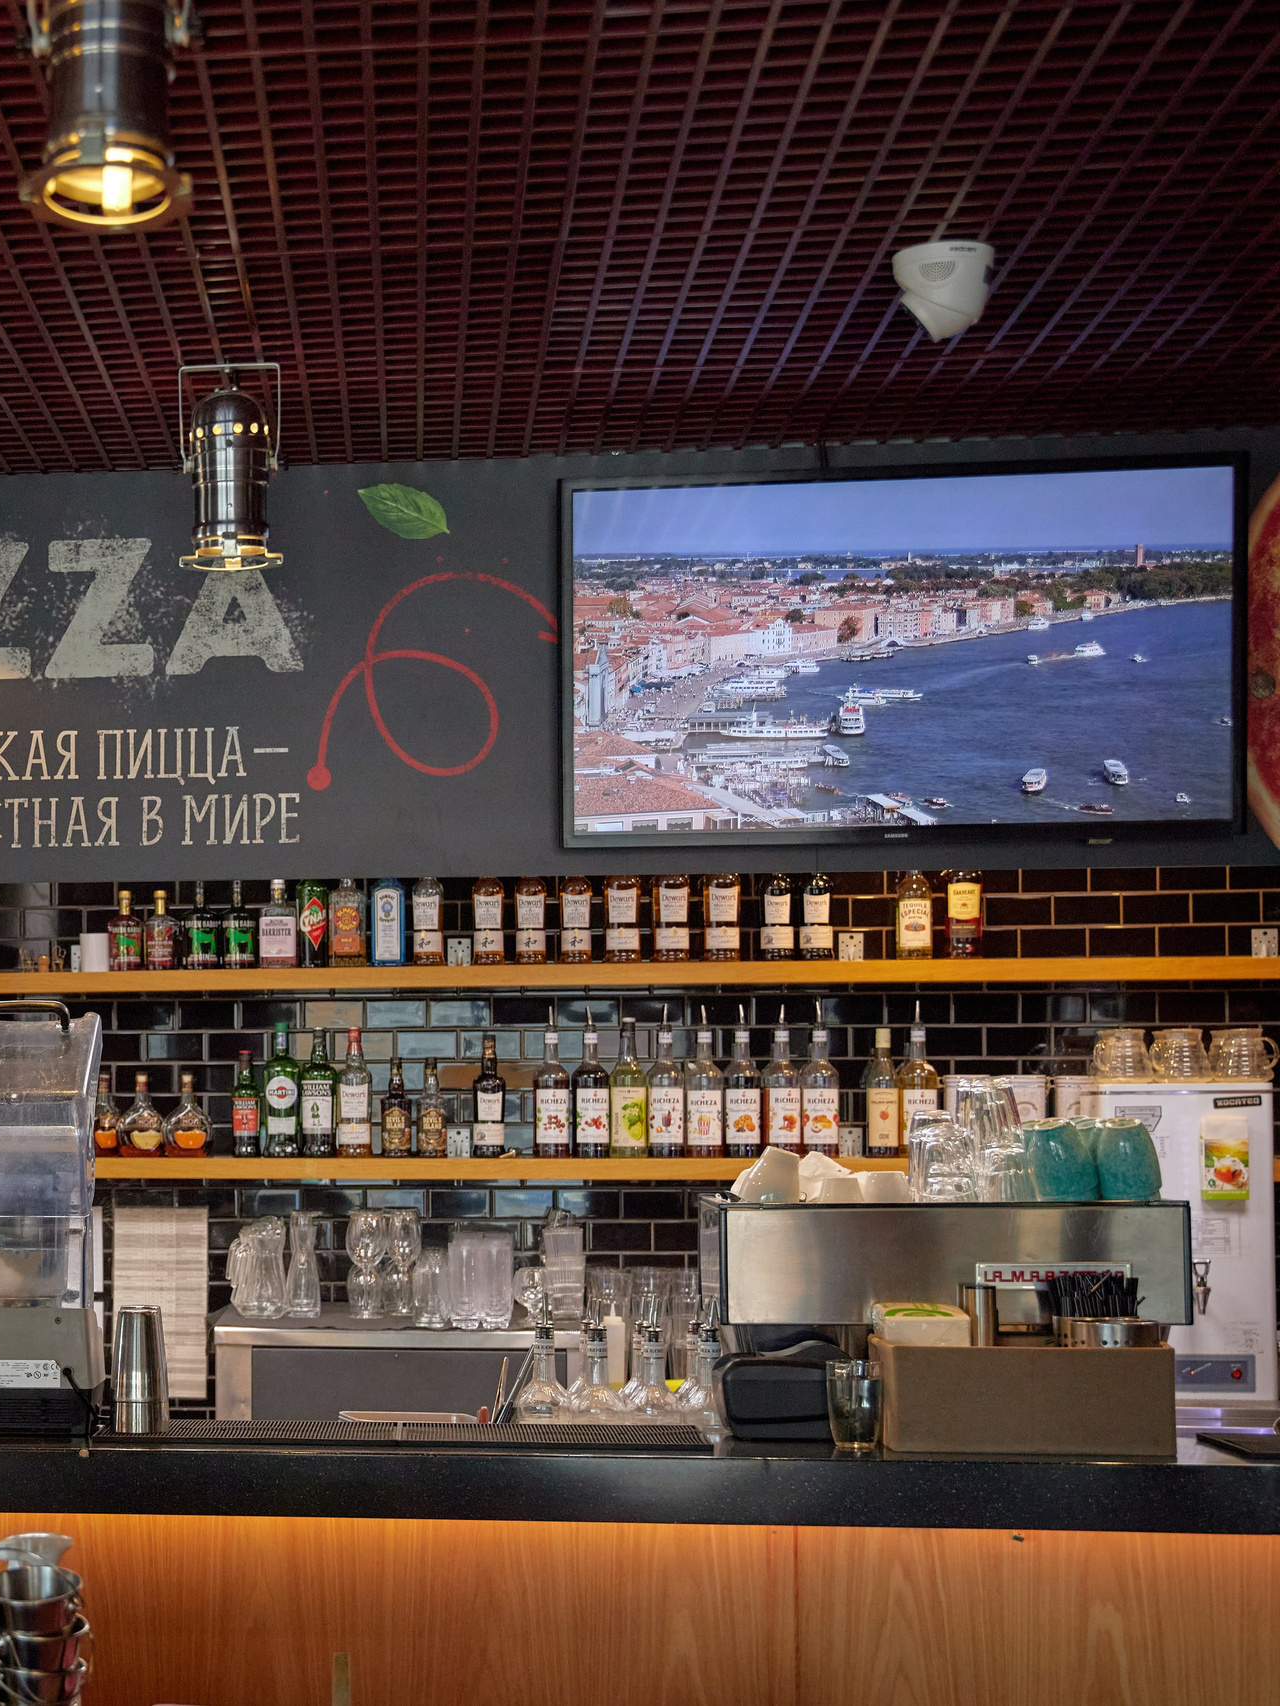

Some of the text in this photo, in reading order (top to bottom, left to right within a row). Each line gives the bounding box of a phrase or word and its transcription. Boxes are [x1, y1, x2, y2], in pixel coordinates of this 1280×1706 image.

[140, 795, 164, 847] В
[181, 793, 300, 846] МИРЕ
[902, 902, 928, 910] TEQUILA
[336, 906, 357, 917] OLMECA
[900, 908, 930, 918] ESPECIAL
[336, 920, 357, 931] TEQUILA
[262, 928, 291, 937] BARRISTER
